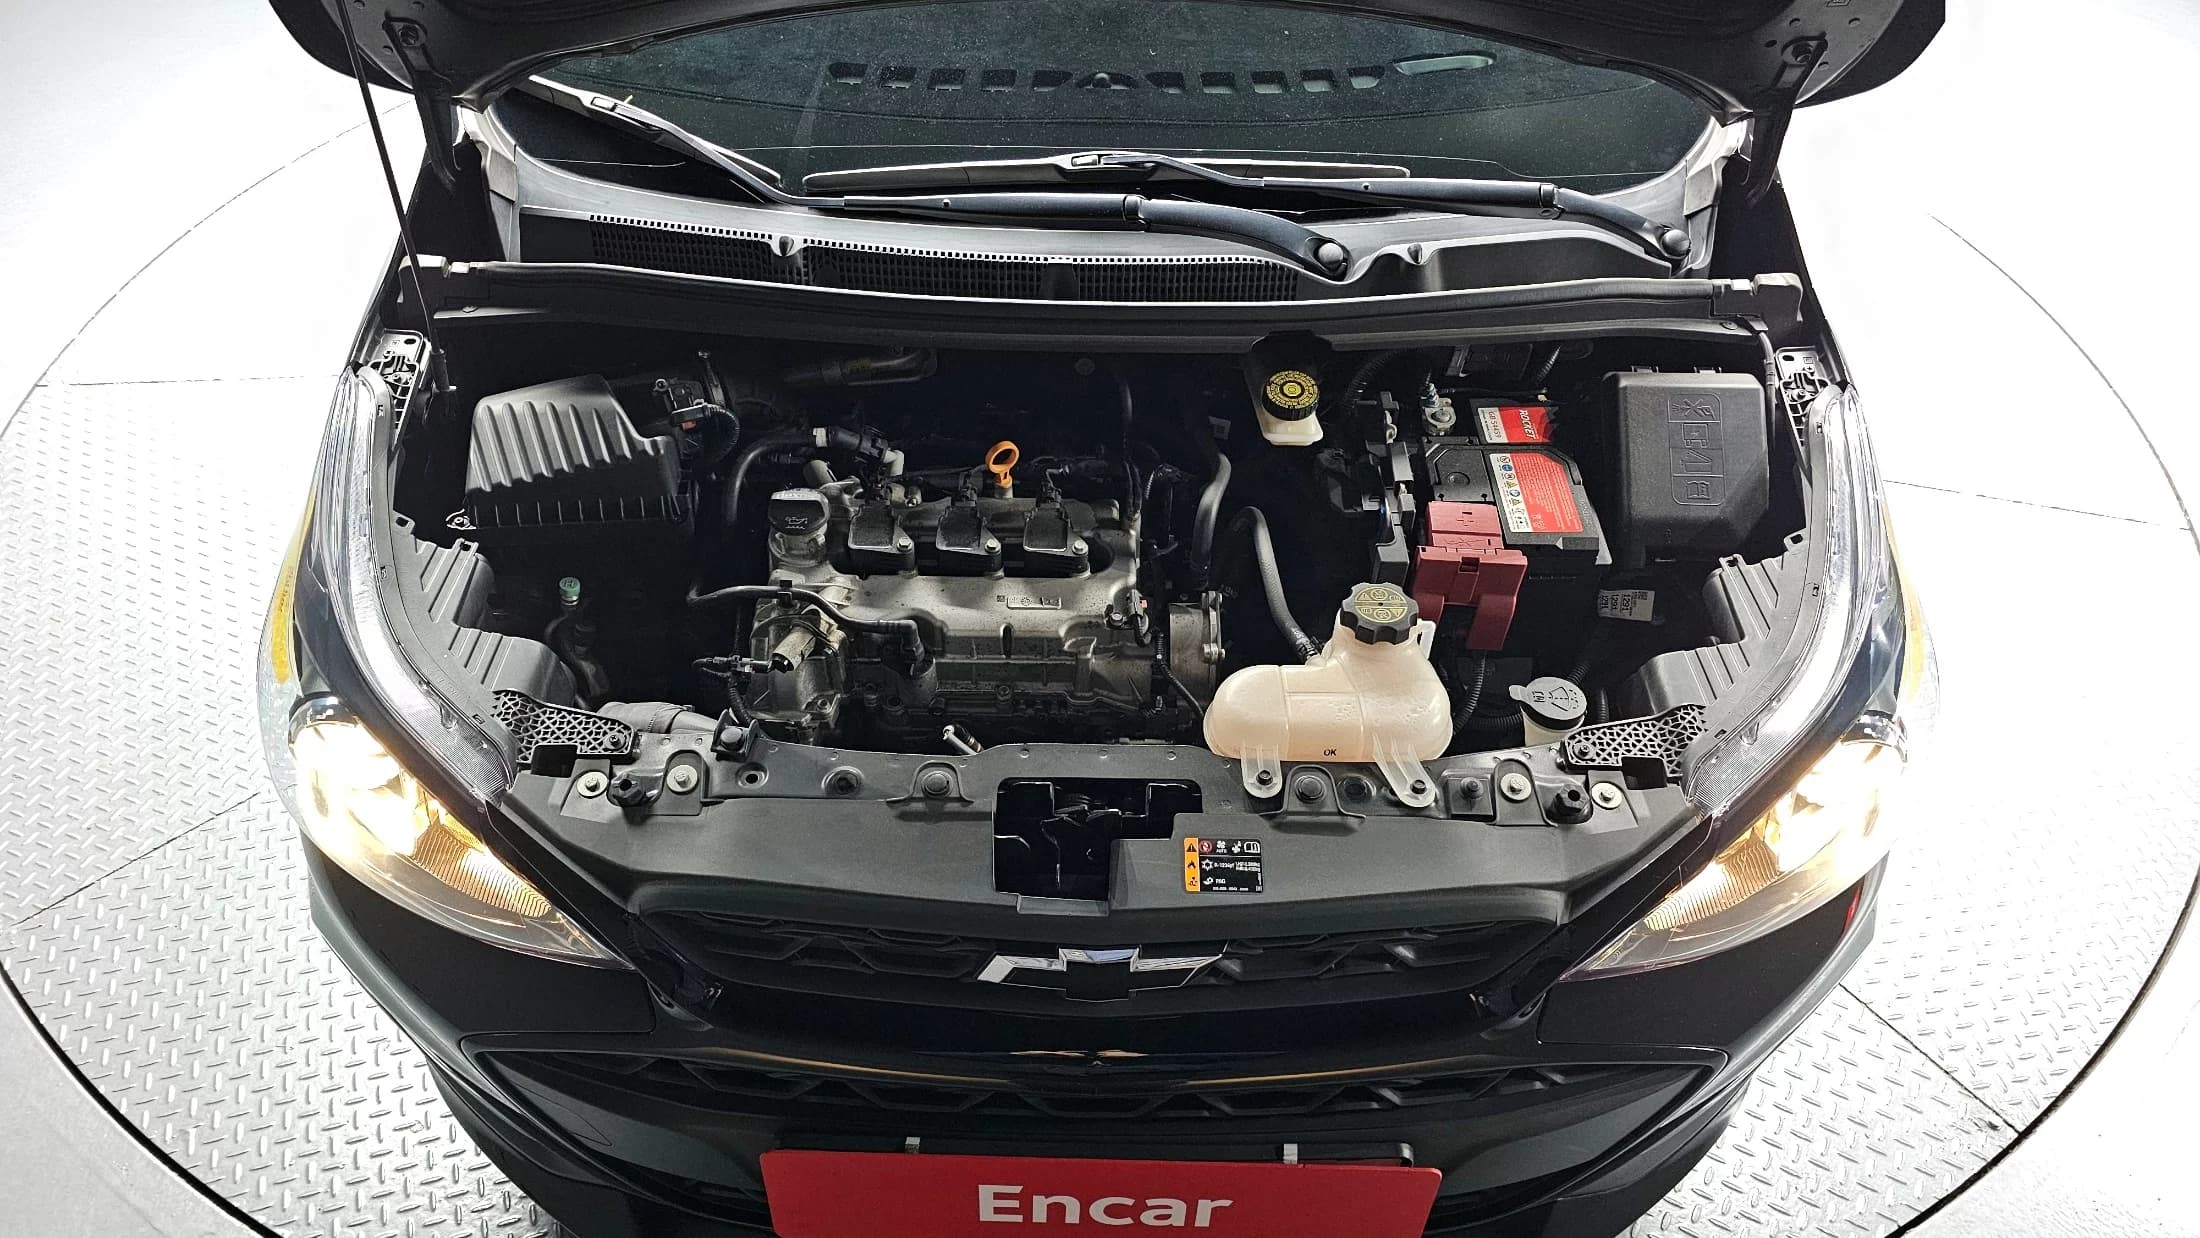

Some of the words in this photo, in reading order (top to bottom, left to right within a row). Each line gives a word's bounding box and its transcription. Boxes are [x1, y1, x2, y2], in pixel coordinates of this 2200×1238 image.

[1519, 409, 1537, 440] ROCKET
[1622, 593, 1630, 611] 1291
[1323, 748, 1337, 757] OK
[978, 1184, 1234, 1228] Encar
